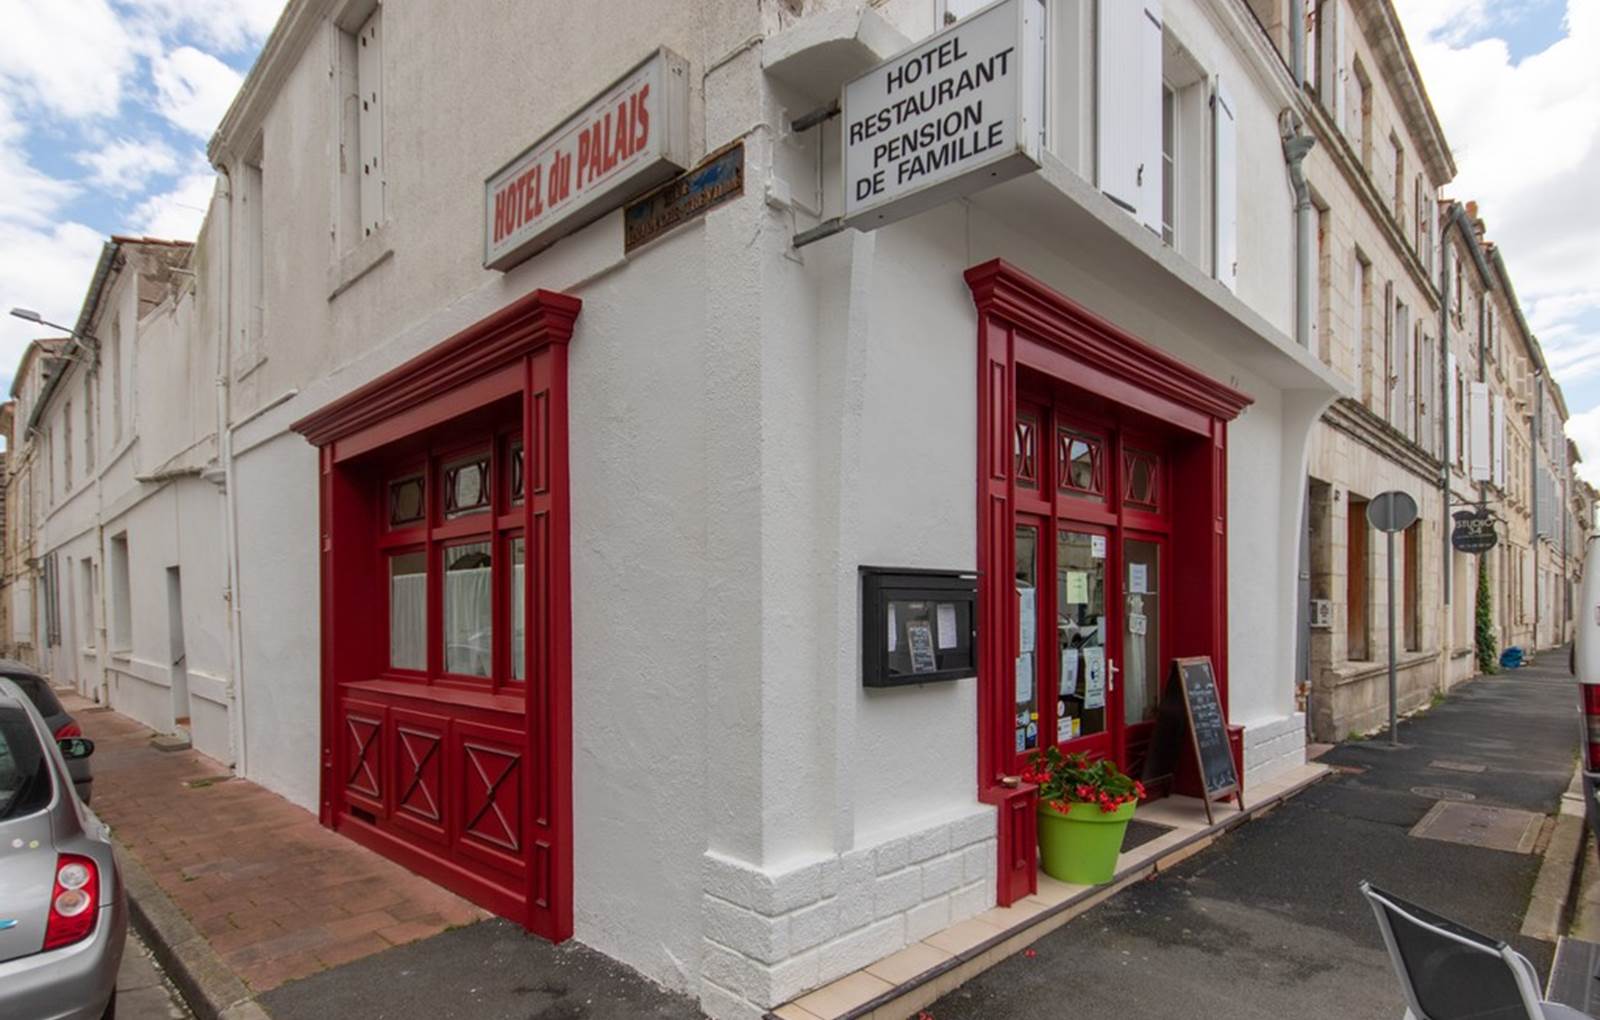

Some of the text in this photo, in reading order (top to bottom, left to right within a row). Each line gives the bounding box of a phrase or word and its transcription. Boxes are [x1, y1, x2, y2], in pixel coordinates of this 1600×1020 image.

[849, 47, 1014, 146] RESTAURANT
[886, 37, 968, 94] HOTEL
[493, 164, 542, 243] HOTEL
[548, 150, 571, 208] du
[576, 83, 649, 190] PALAIS
[855, 121, 1003, 201] DE FAMILLE
[873, 100, 982, 168] PENSION
